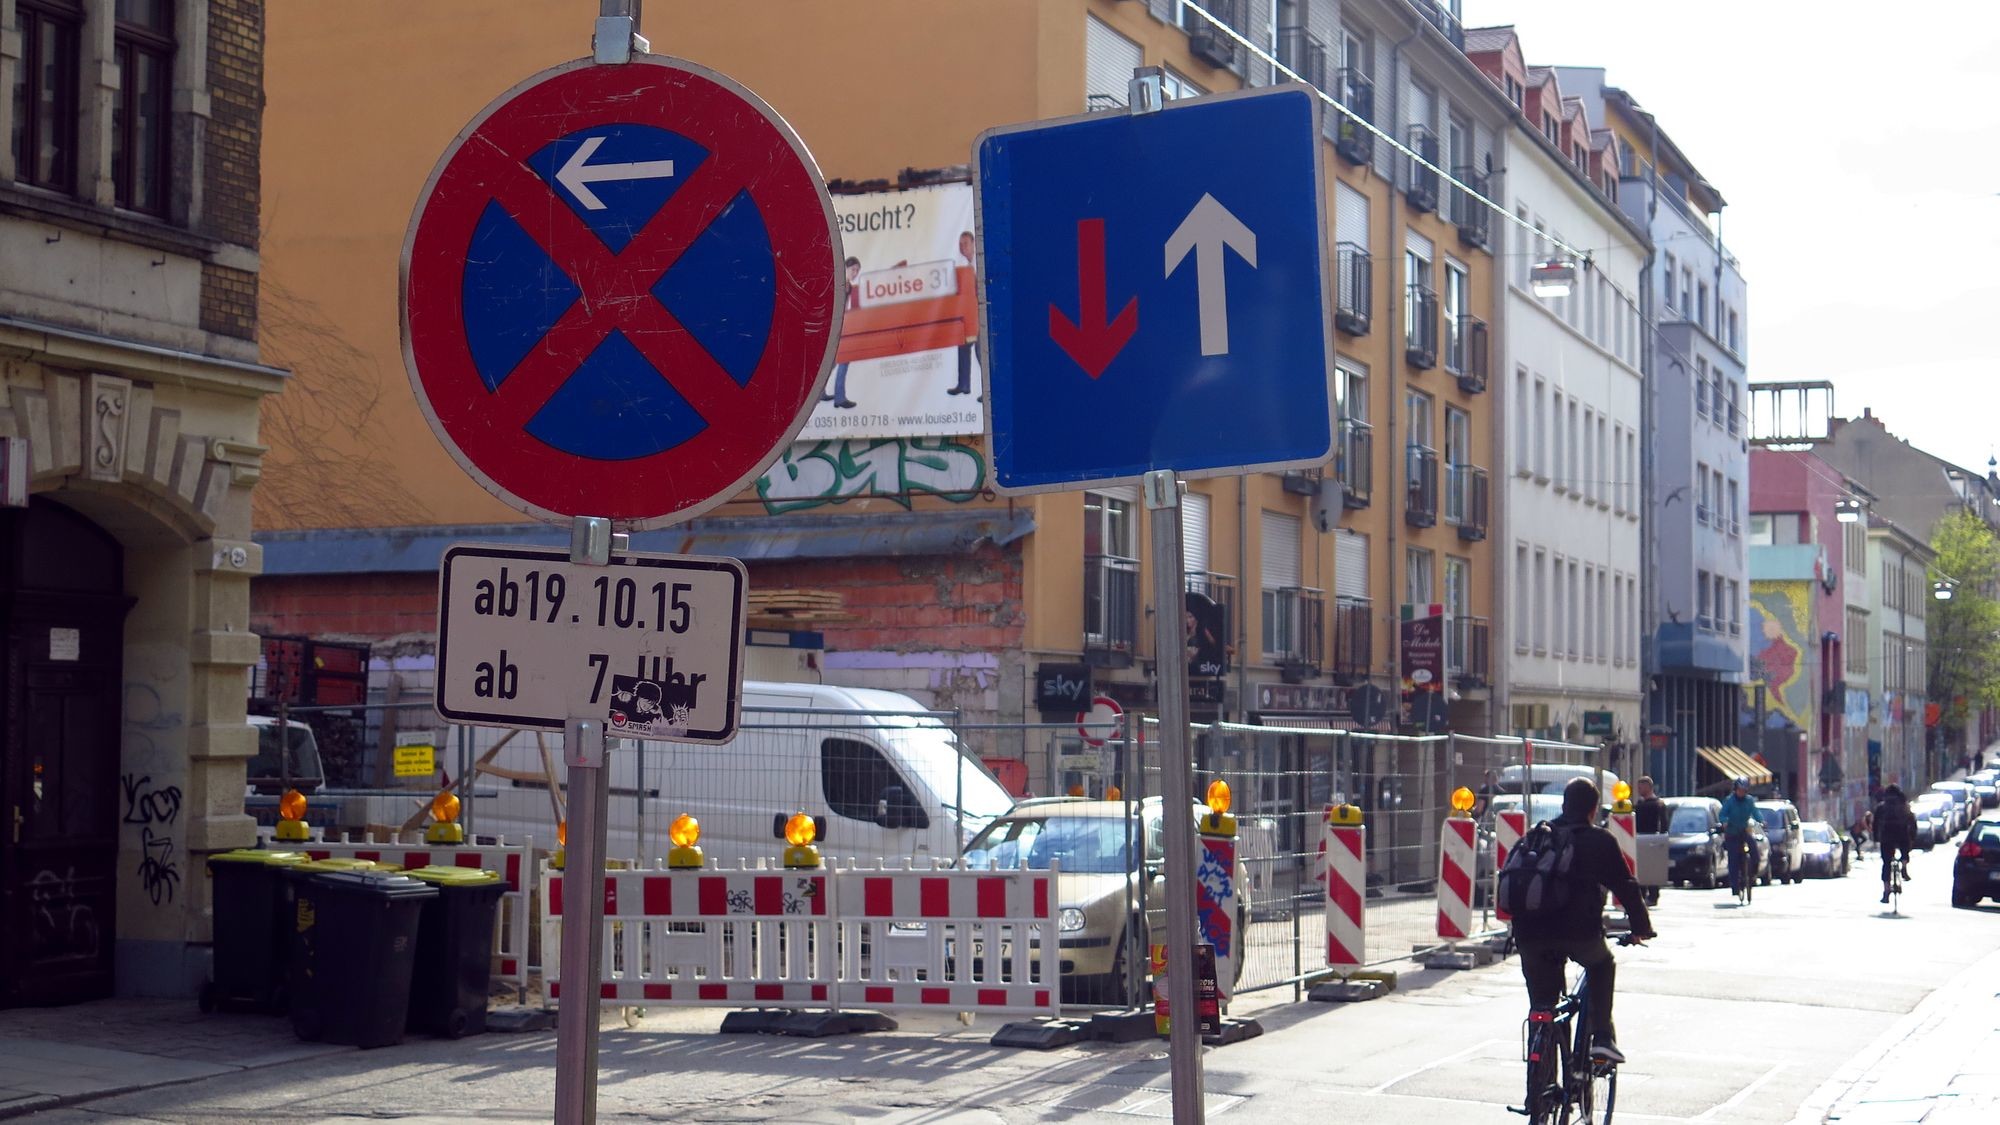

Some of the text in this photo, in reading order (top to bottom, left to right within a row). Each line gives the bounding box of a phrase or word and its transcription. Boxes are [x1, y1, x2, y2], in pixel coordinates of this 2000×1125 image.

[866, 267, 949, 299] Louise 31
[814, 416, 837, 428] 0351
[841, 415, 859, 427] 818
[861, 415, 868, 426] 0
[871, 414, 889, 426] 718
[897, 411, 977, 425] www.louise31.de
[474, 650, 518, 700] ab
[589, 654, 609, 704] 7
[1200, 661, 1221, 675] sky
[1043, 674, 1084, 700] sky
